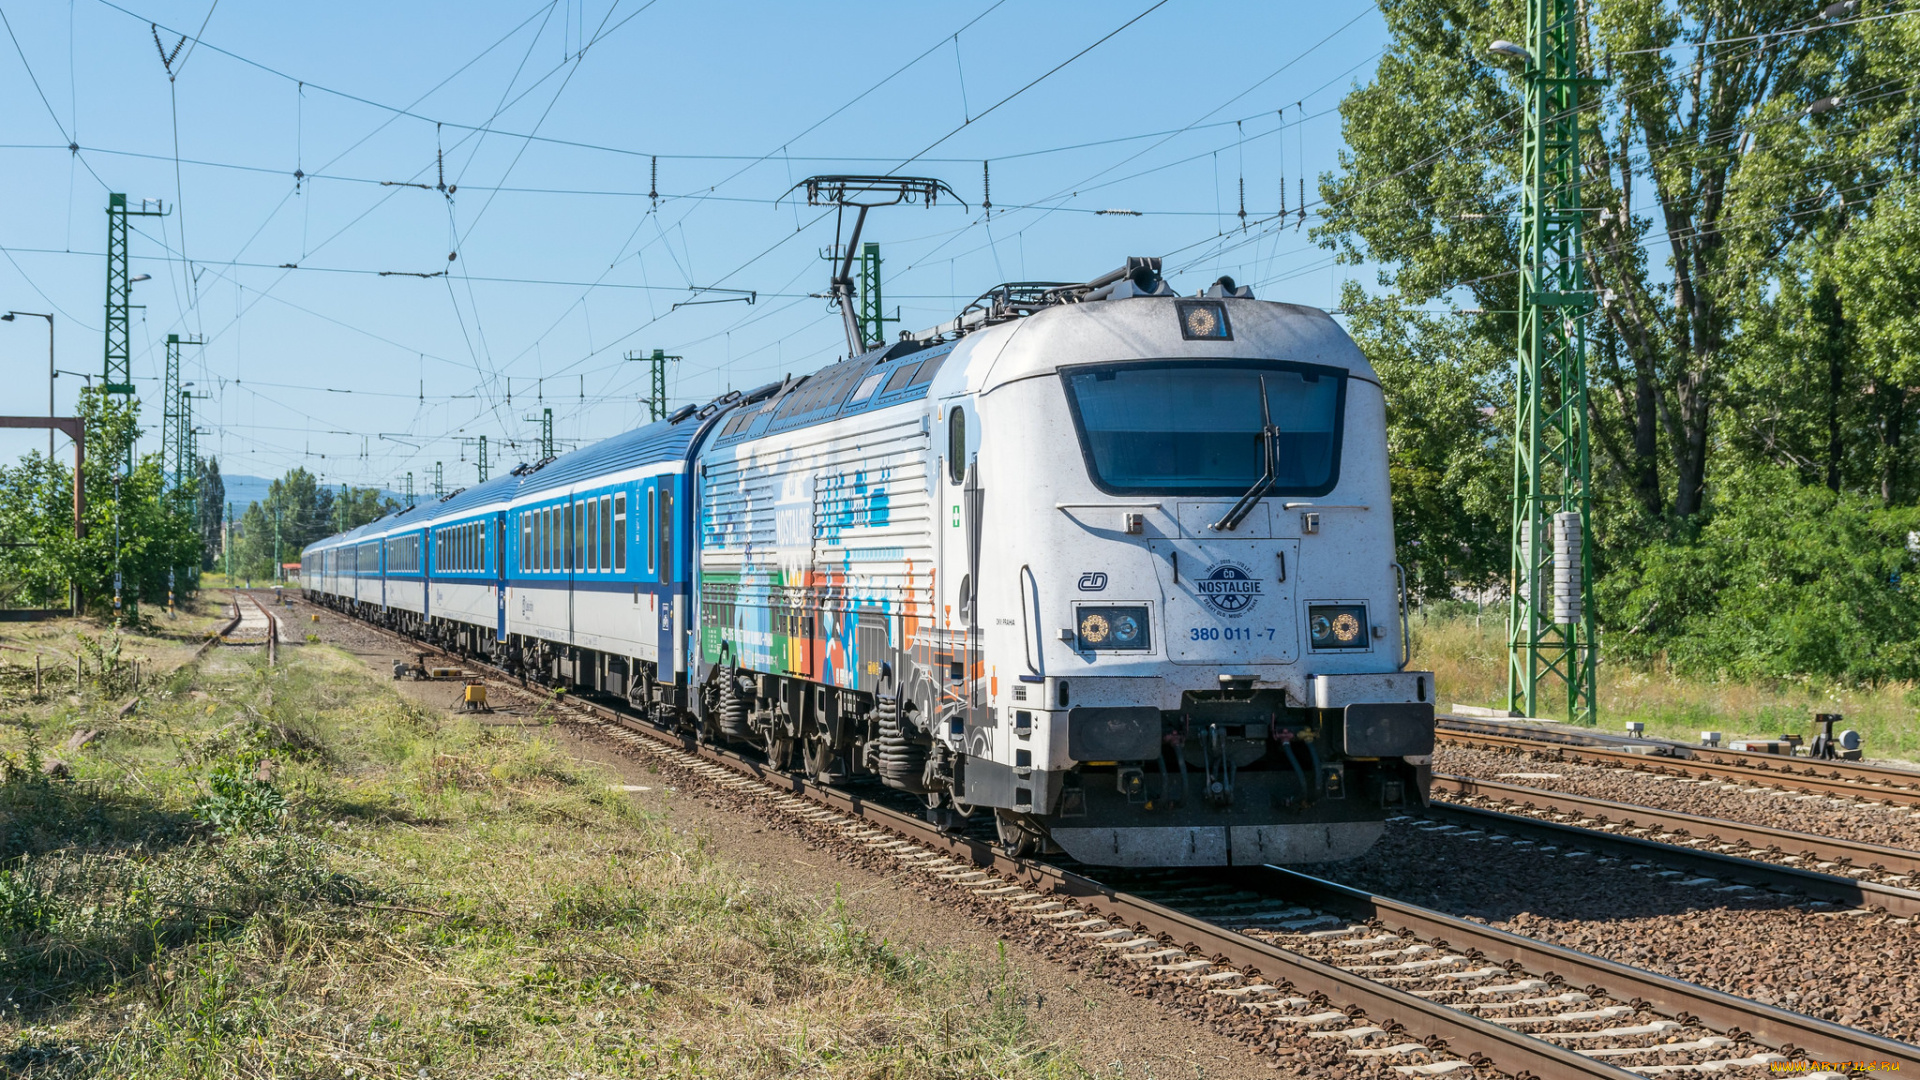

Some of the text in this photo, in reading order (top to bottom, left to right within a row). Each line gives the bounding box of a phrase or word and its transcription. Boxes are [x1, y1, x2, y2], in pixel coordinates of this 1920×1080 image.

[1223, 569, 1235, 578] ČD
[1198, 581, 1261, 593] NOSTALGIE
[1190, 628, 1219, 641] 380
[1224, 627, 1250, 640] 011
[1267, 629, 1276, 641] 7
